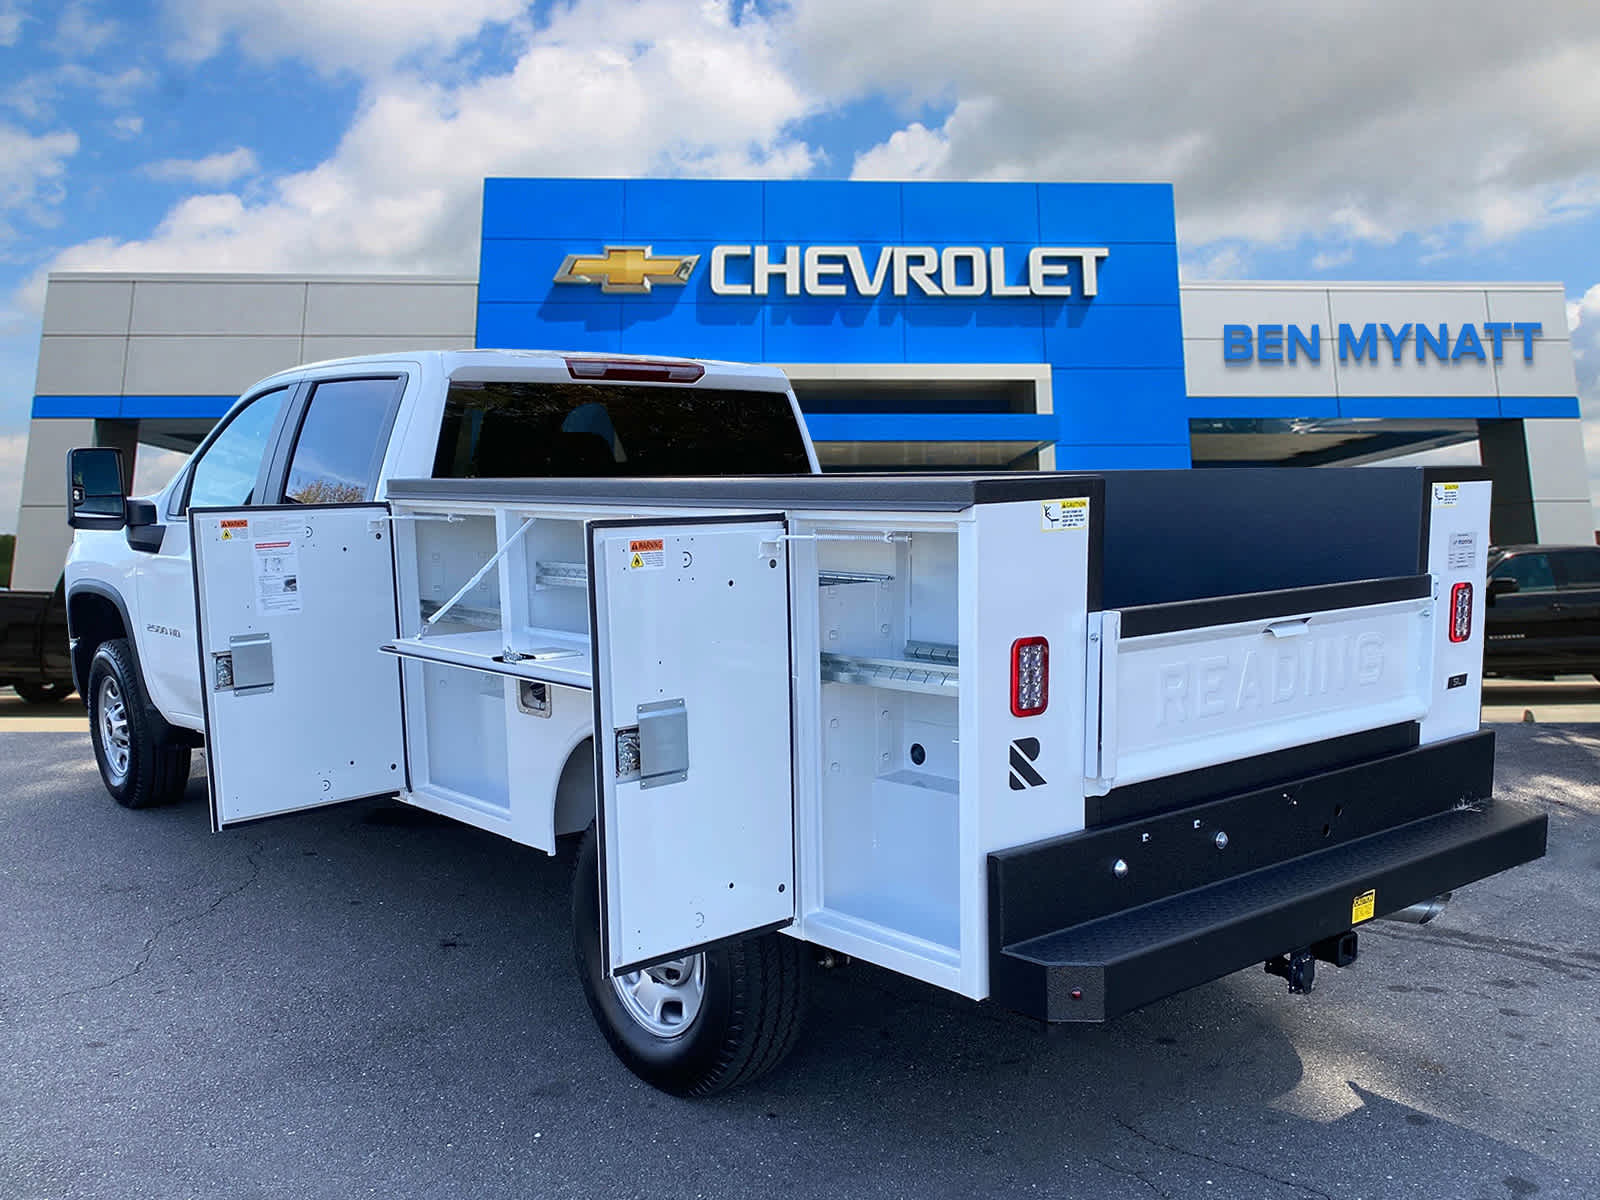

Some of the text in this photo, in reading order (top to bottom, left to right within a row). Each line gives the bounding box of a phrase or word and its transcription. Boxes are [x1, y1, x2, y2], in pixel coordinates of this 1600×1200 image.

[710, 245, 1110, 297] CHEVROLET
[1223, 322, 1543, 364] BEN MYNATT
[639, 539, 663, 551] WARNING
[1155, 631, 1385, 728] READING
